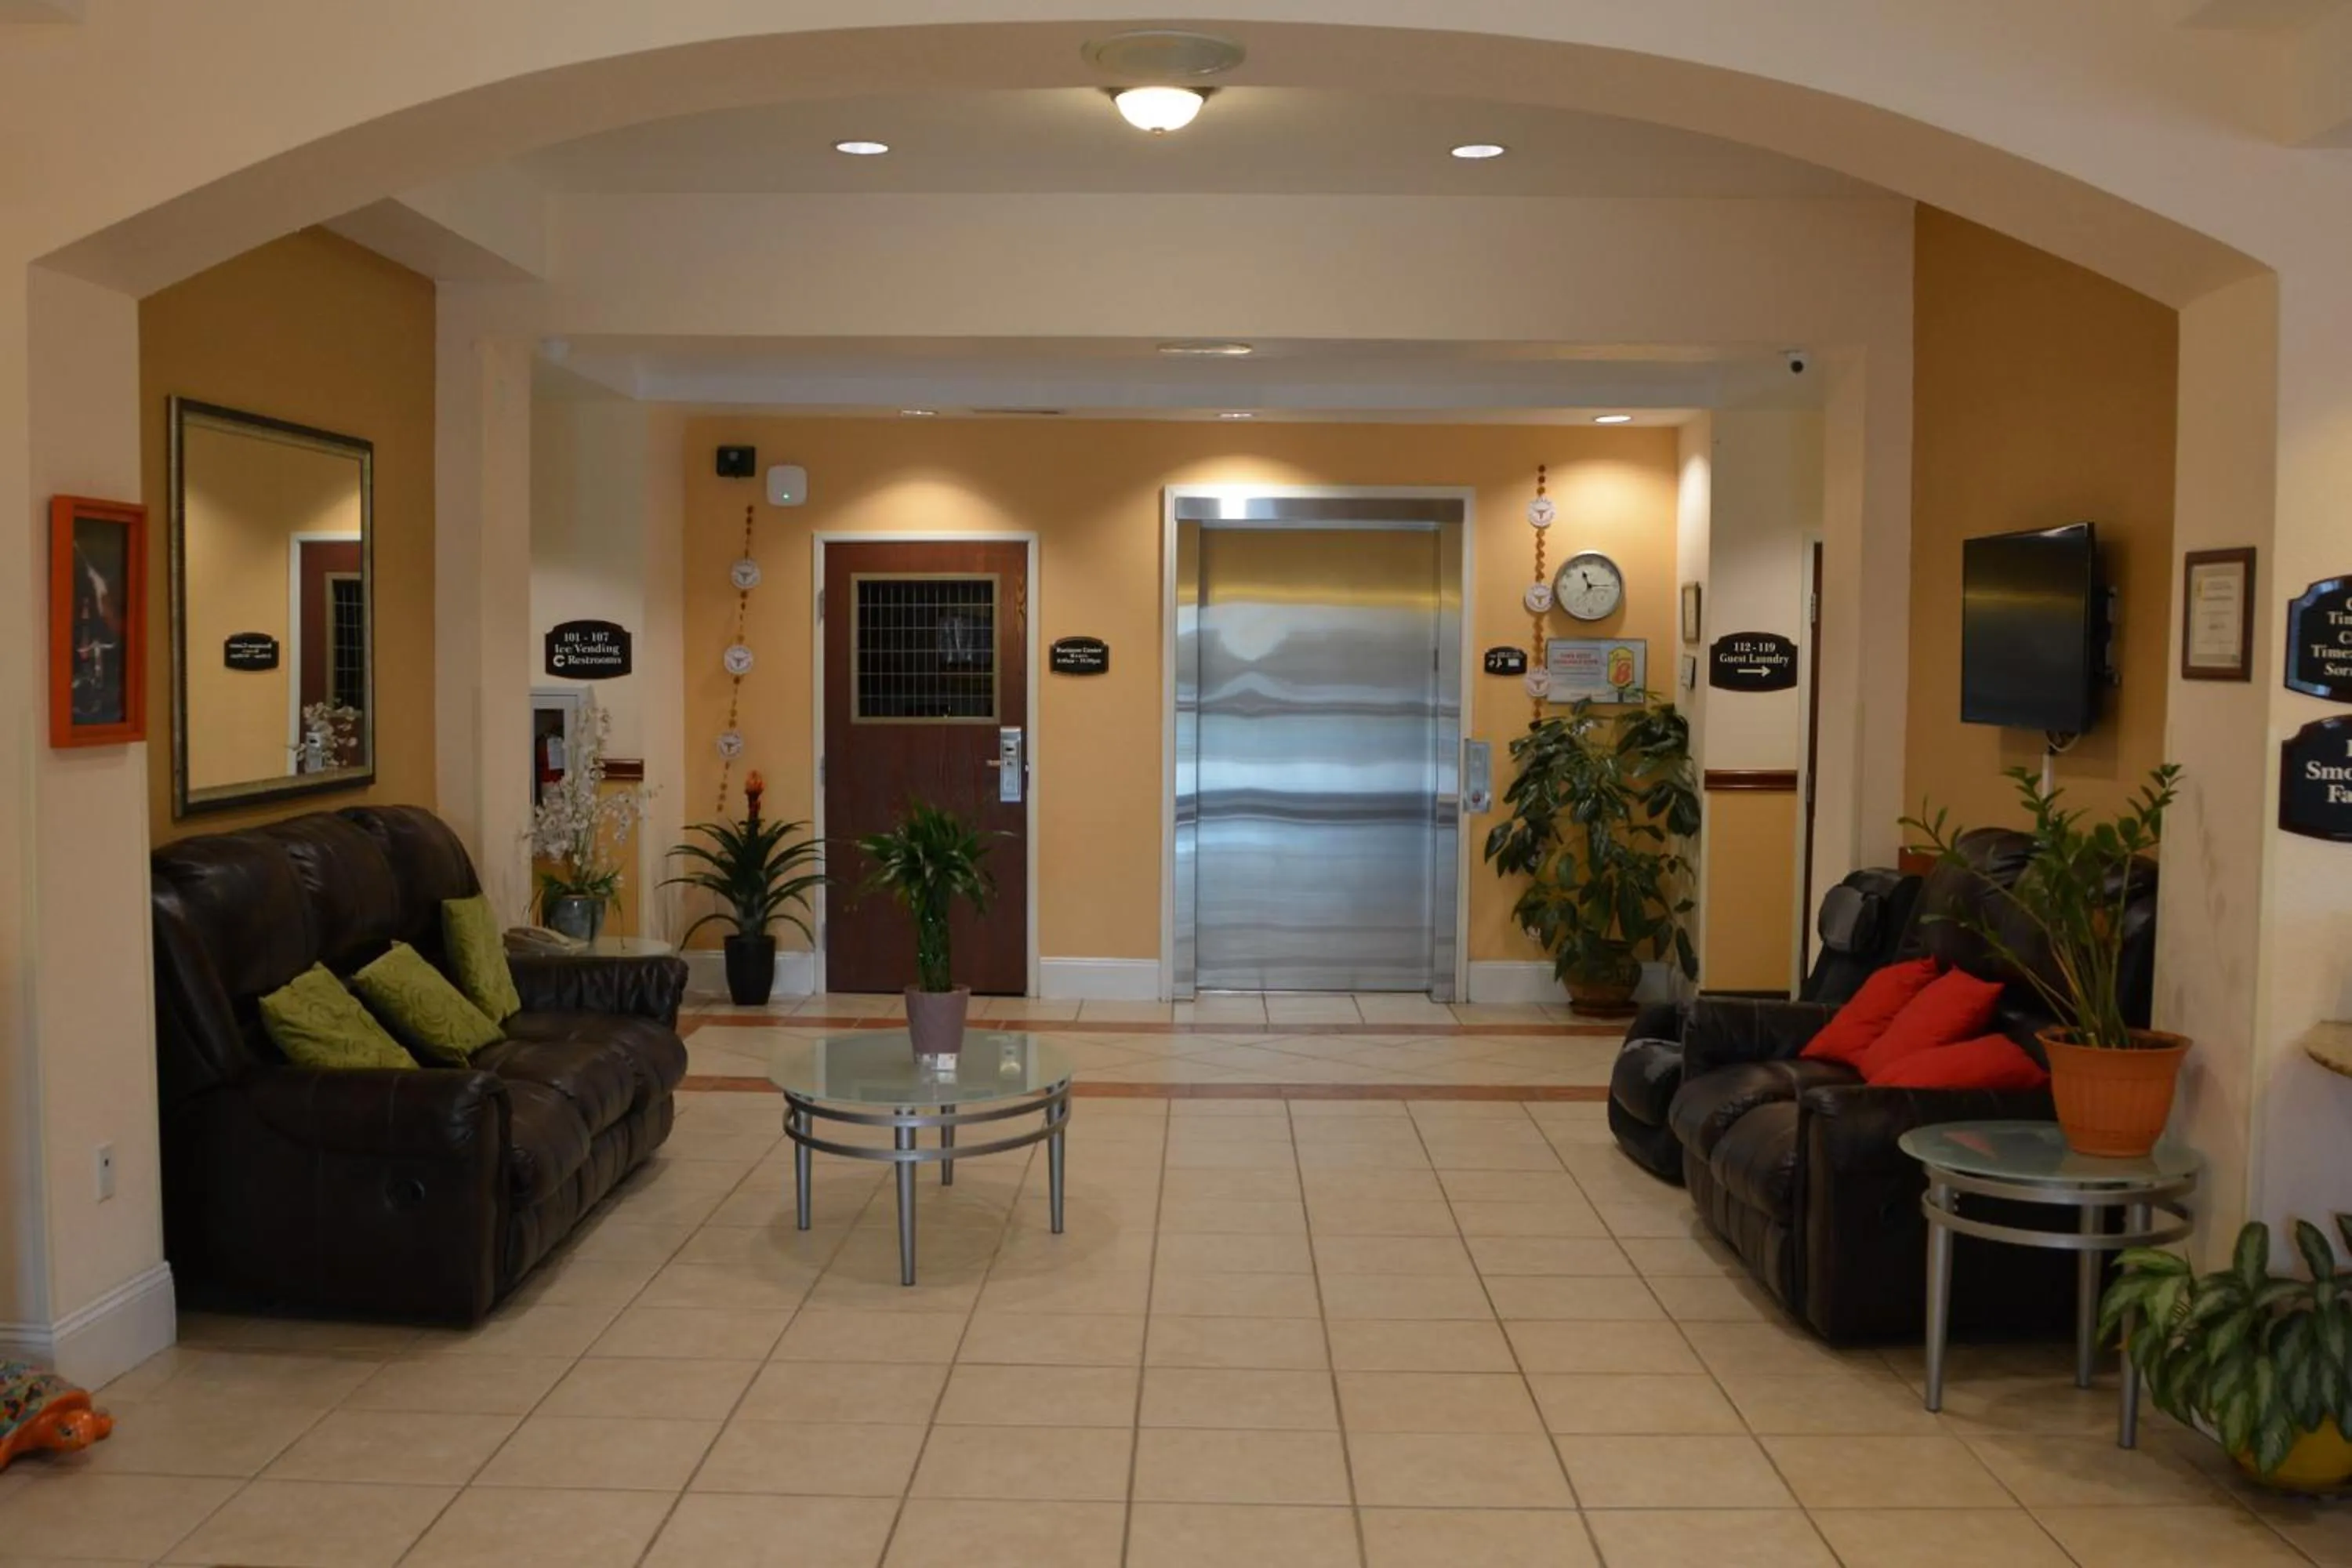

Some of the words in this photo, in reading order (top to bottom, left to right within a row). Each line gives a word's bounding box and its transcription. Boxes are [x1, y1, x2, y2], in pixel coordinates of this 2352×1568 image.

[564, 633, 581, 642] 101
[592, 632, 610, 642] 107
[554, 644, 572, 653] Ice
[575, 644, 620, 655] Vending
[1734, 642, 1751, 652] 112
[1759, 642, 1777, 652] 119
[568, 655, 622, 665] Restrooms
[1719, 652, 1747, 663] Guest
[1749, 653, 1790, 667] Laundry
